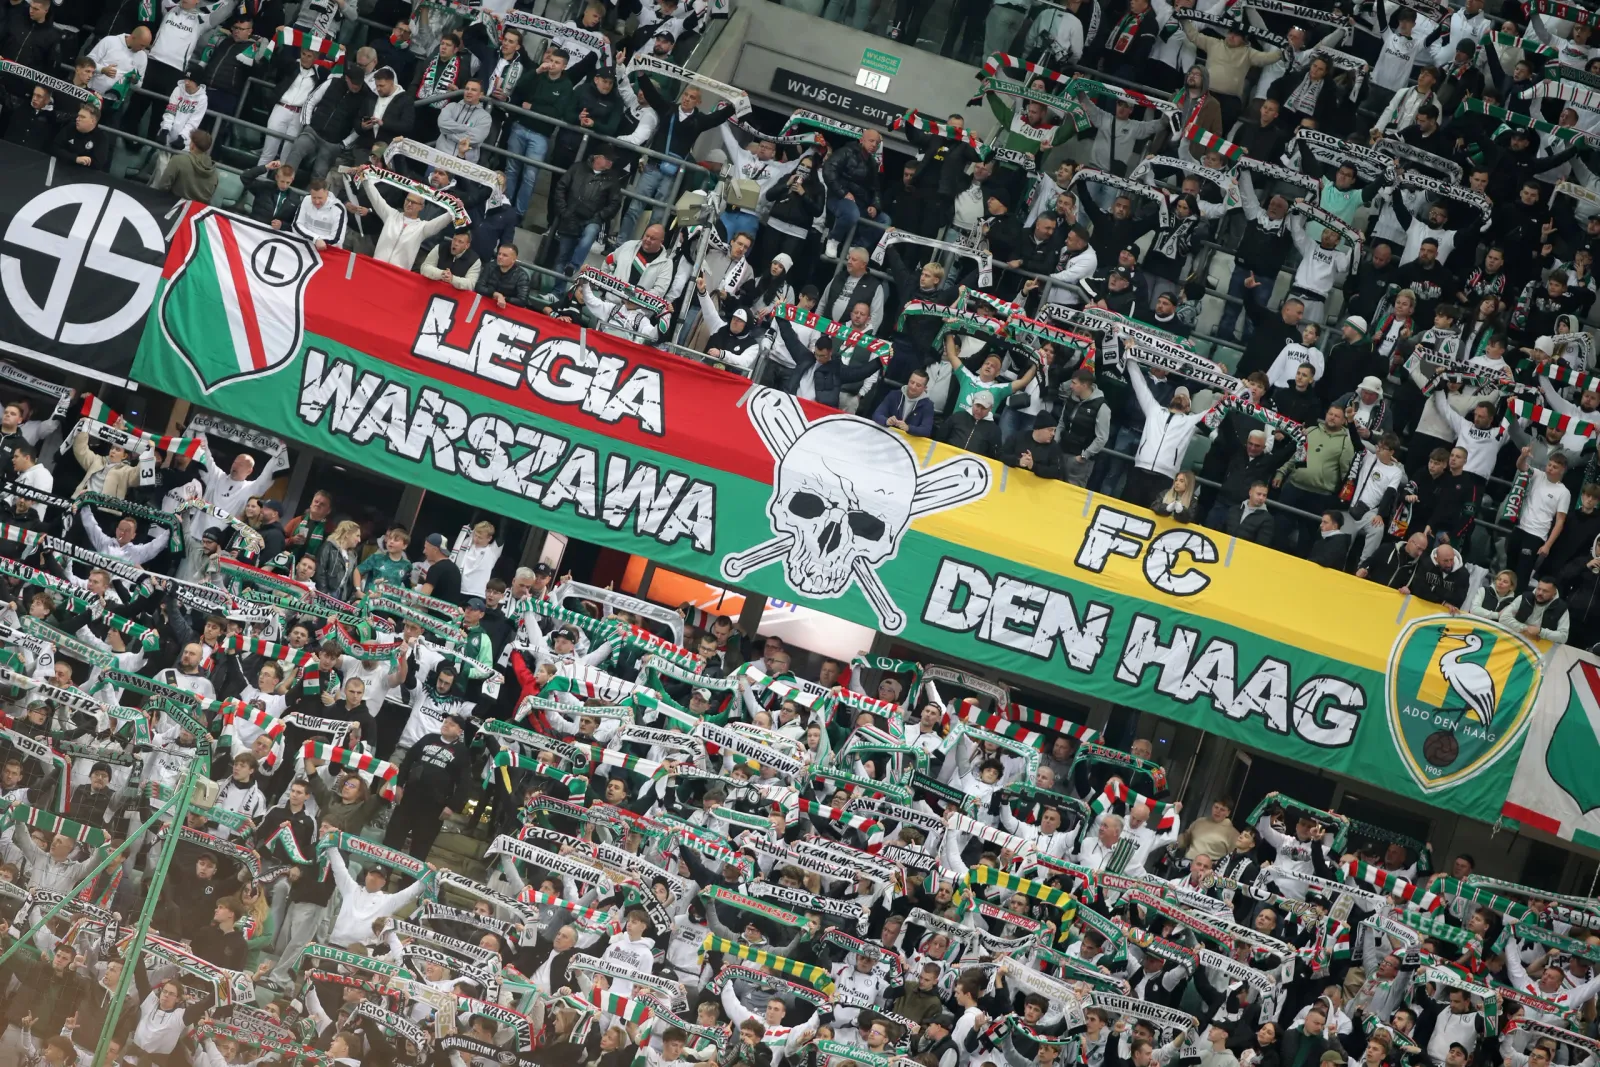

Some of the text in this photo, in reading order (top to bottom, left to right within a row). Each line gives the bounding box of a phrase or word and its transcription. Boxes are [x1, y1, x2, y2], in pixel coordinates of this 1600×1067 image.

[2, 61, 89, 102] LEGIA WARSZAWA
[633, 57, 744, 98] MISTRZ 2020
[788, 78, 853, 110] WYJŚCIE
[862, 105, 888, 121] EXIT
[801, 110, 864, 135] WARSZA
[434, 153, 502, 187] WARSZAW
[921, 302, 991, 326] MARKI
[1018, 320, 1093, 350] MARKI
[1122, 325, 1217, 371] LEGIA WARSZAWA
[412, 293, 666, 437] LEGIA
[1129, 347, 1177, 371] ULTRAS
[221, 424, 280, 453] WARSZAWA
[296, 346, 717, 555] WARSZAWA
[13, 485, 74, 512] WARSZAW
[42, 534, 139, 582] LEGIA WARSZAWA
[1074, 505, 1219, 596] FC
[921, 556, 1113, 674] DEN
[1114, 611, 1366, 749] HAAG
[38, 684, 101, 715] MISTRZ
[1403, 704, 1497, 743] ADO DEN HAAG
[17, 736, 49, 757] 1916
[701, 727, 801, 776] LEGIA WARSZAWA
[1425, 764, 1443, 777] 1905
[348, 837, 423, 872] CWKS LEGIA
[502, 841, 600, 885] LEGIA WARSZAWA
[797, 856, 860, 884] WARSZAW
[399, 919, 490, 960] LEGIA WARSZAWA
[1405, 913, 1472, 945] LEGIA
[837, 983, 870, 1000] Plus500
[1201, 951, 1223, 967] EGIA
[1226, 959, 1274, 995] WARSZAWA
[482, 1003, 533, 1053] WARSZAWA
[1097, 995, 1195, 1029] LEGIA WARSZAWA
